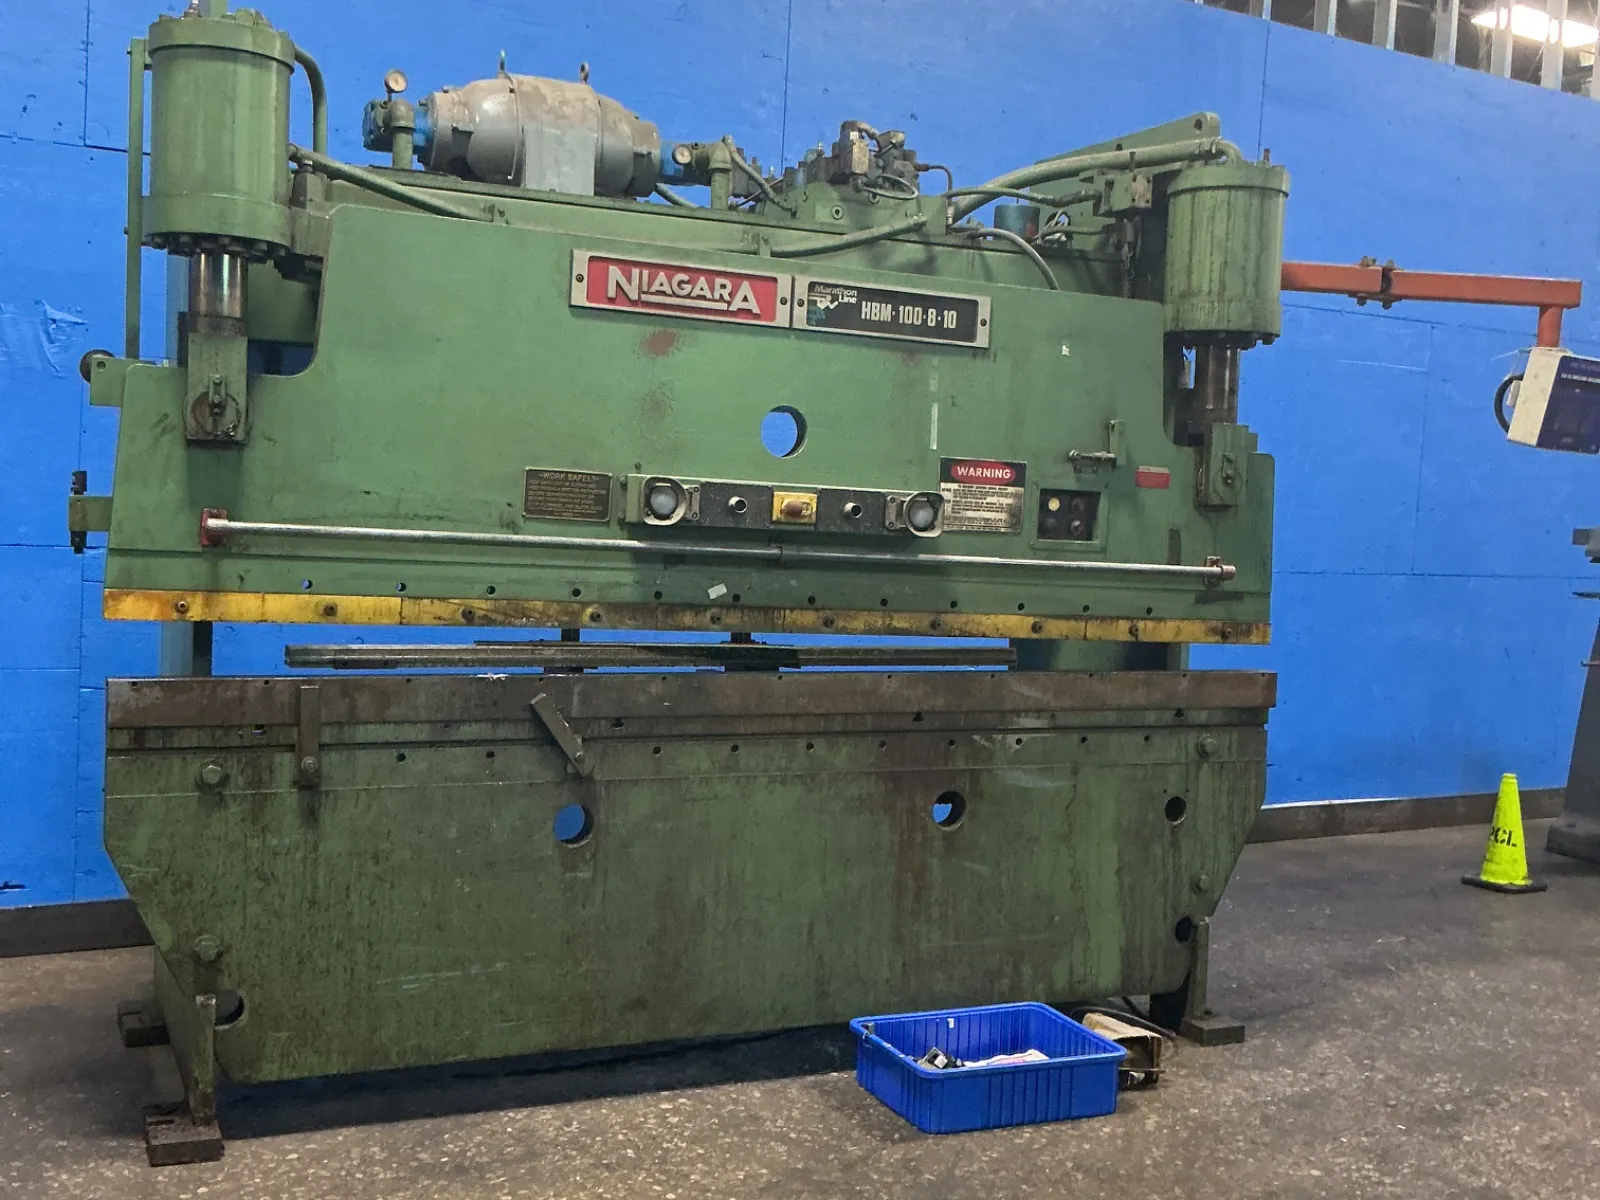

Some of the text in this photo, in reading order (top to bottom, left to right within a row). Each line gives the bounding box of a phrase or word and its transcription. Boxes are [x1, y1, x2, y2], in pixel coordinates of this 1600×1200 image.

[607, 265, 761, 314] NIAGARA
[814, 284, 857, 297] Marathon
[838, 294, 857, 304] Line
[957, 466, 1011, 479] WARNING
